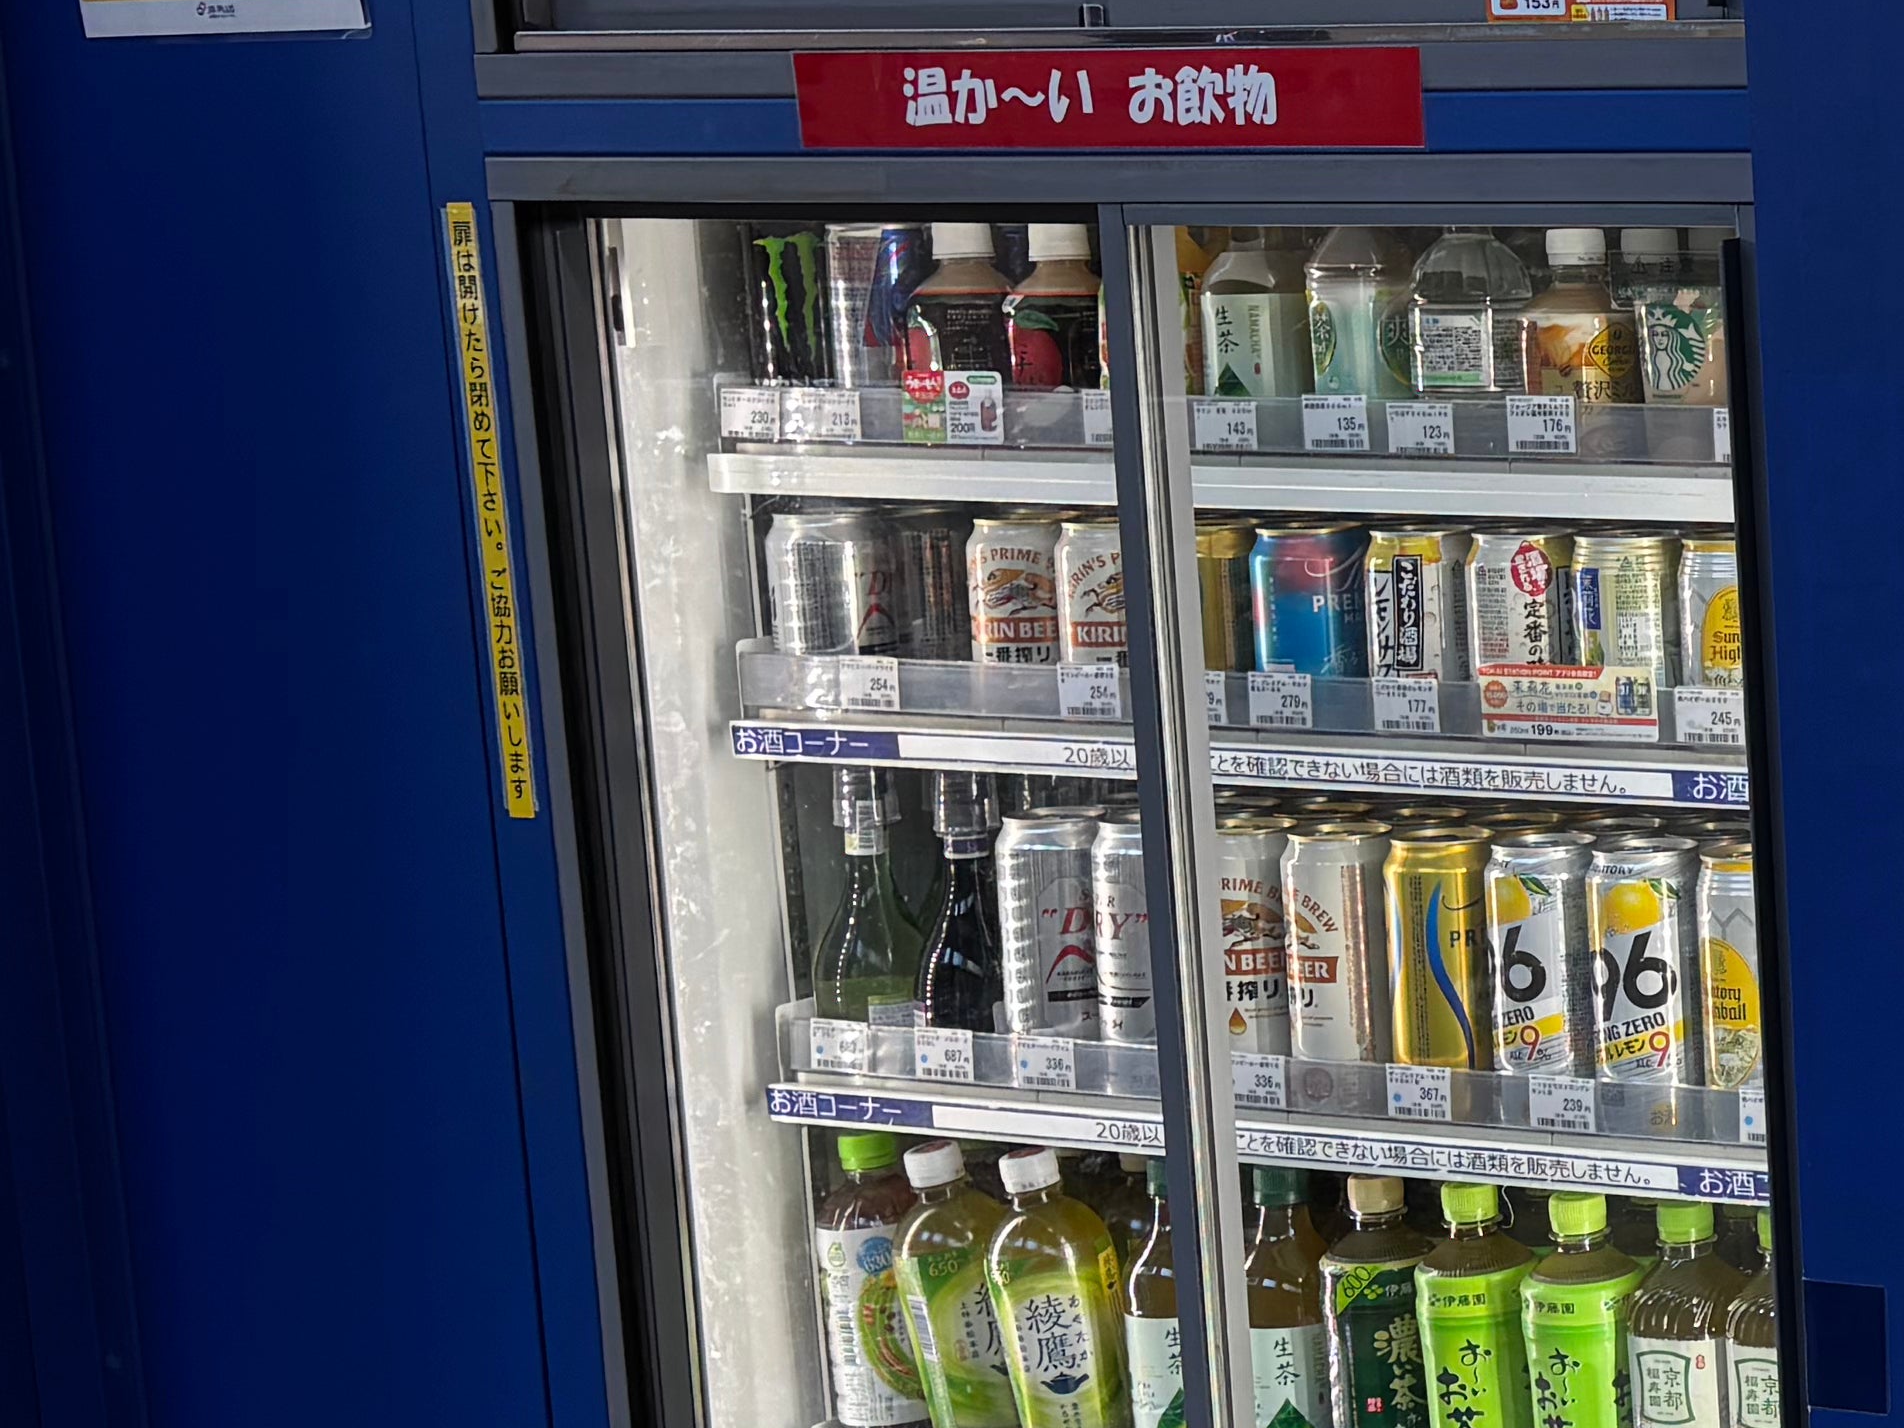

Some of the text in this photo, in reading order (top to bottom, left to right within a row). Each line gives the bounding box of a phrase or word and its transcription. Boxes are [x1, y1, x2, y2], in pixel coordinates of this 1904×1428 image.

[1127, 63, 1278, 127] お飲物
[1214, 305, 1240, 356] 生茶
[735, 728, 870, 756] お酒コーナー
[769, 1090, 902, 1124] お酒コーナー
[1442, 1292, 1487, 1307] 伊藤園
[1662, 1368, 1684, 1412] 京都
